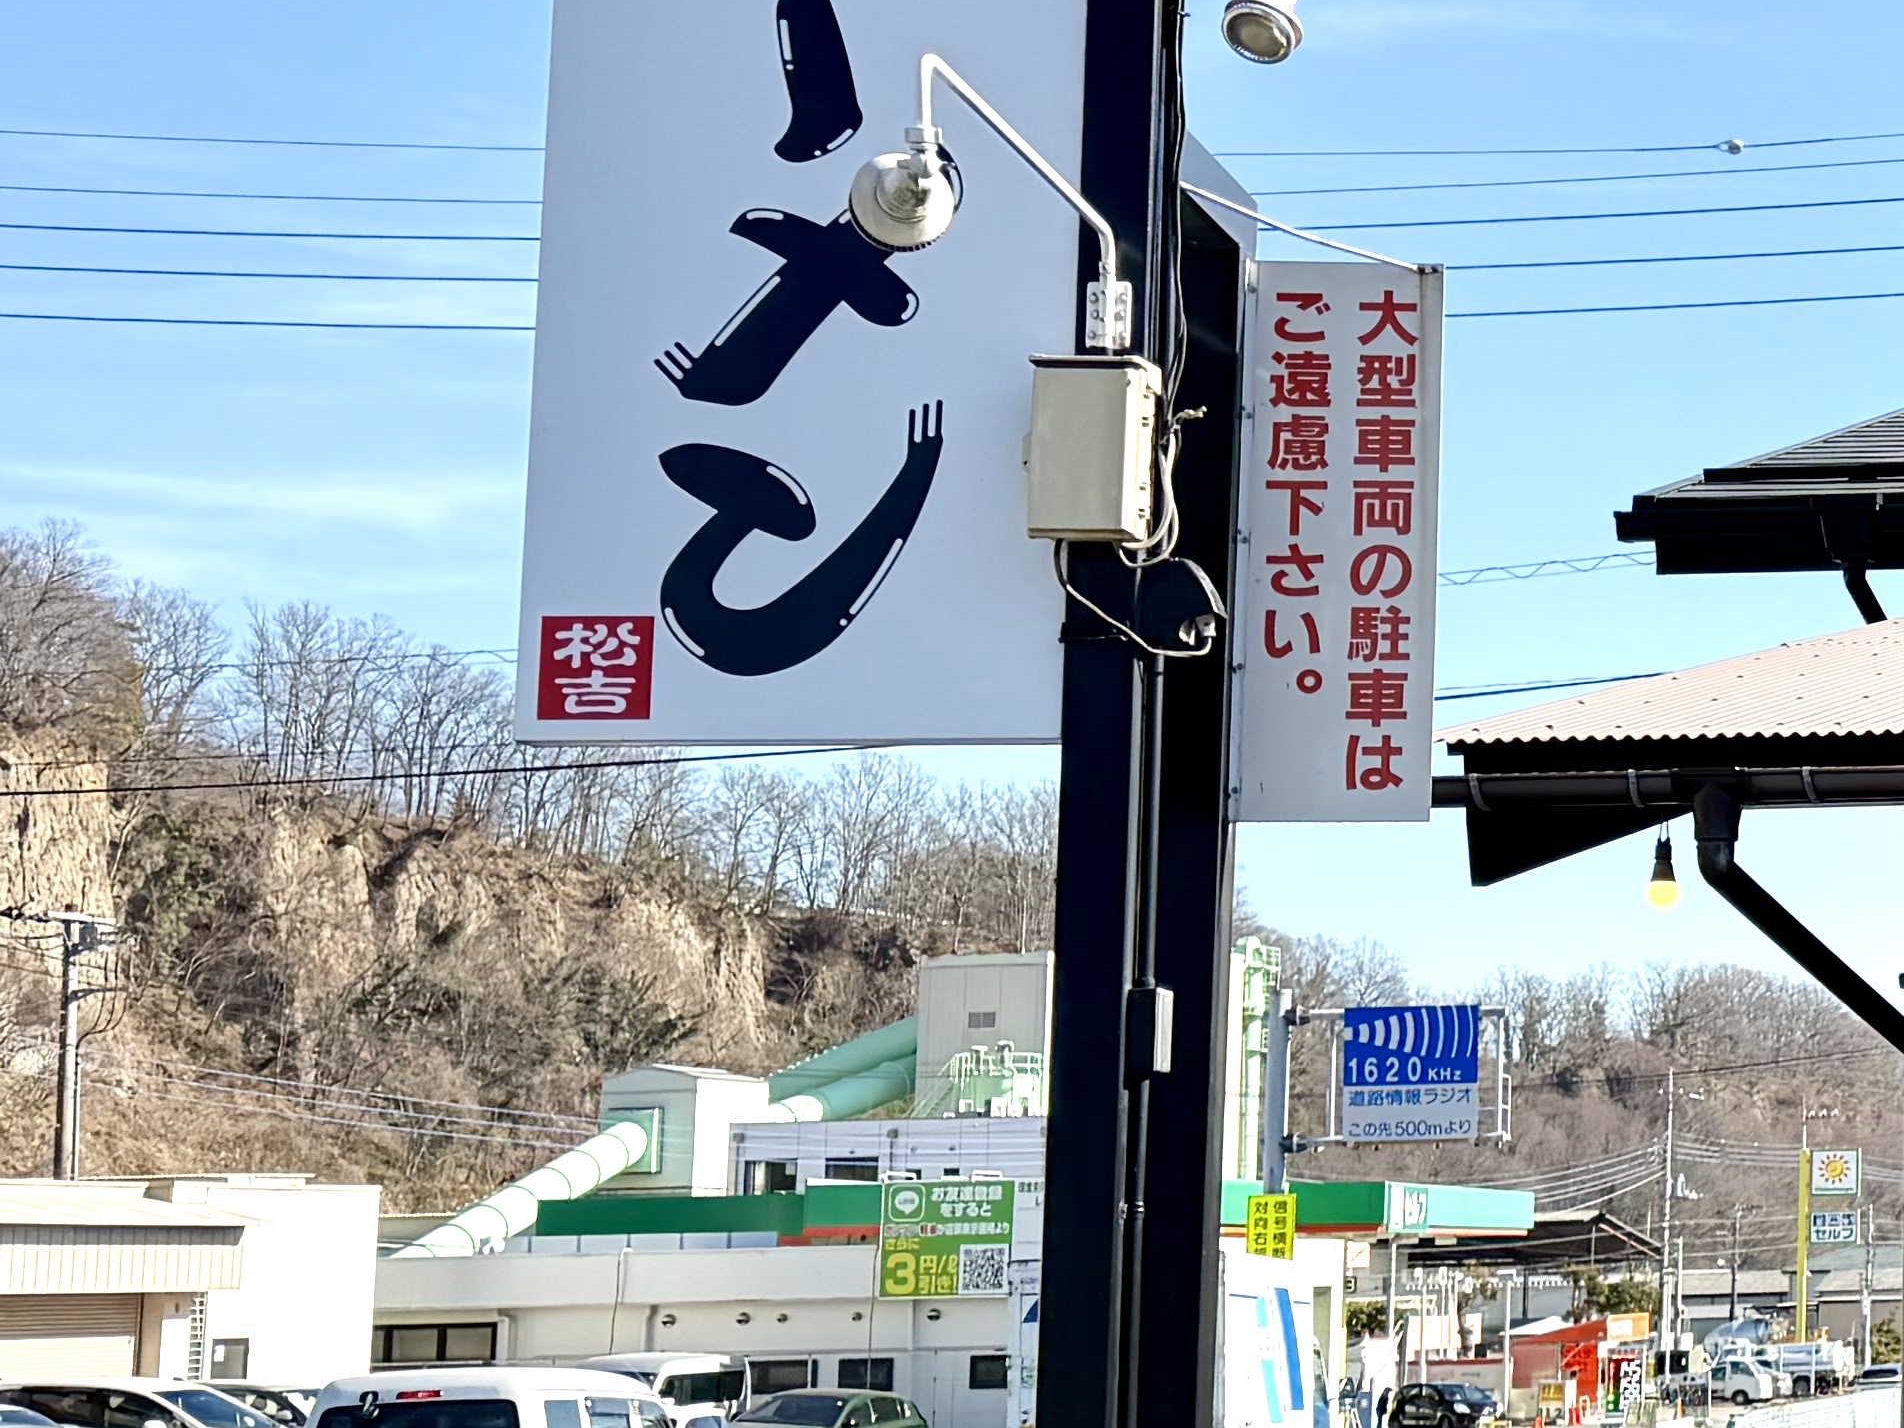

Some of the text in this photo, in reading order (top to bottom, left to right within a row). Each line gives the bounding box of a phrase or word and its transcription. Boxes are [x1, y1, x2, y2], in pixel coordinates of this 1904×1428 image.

[1264, 291, 1332, 696] ご遠慮下さい。
[1346, 289, 1419, 791] 大型車両の駐車は
[553, 620, 640, 716] 松吉
[1348, 1056, 1462, 1083] 1620 KHz
[1348, 1087, 1472, 1107] 道路情報ラジオ
[1349, 1119, 1472, 1137] この先500mより
